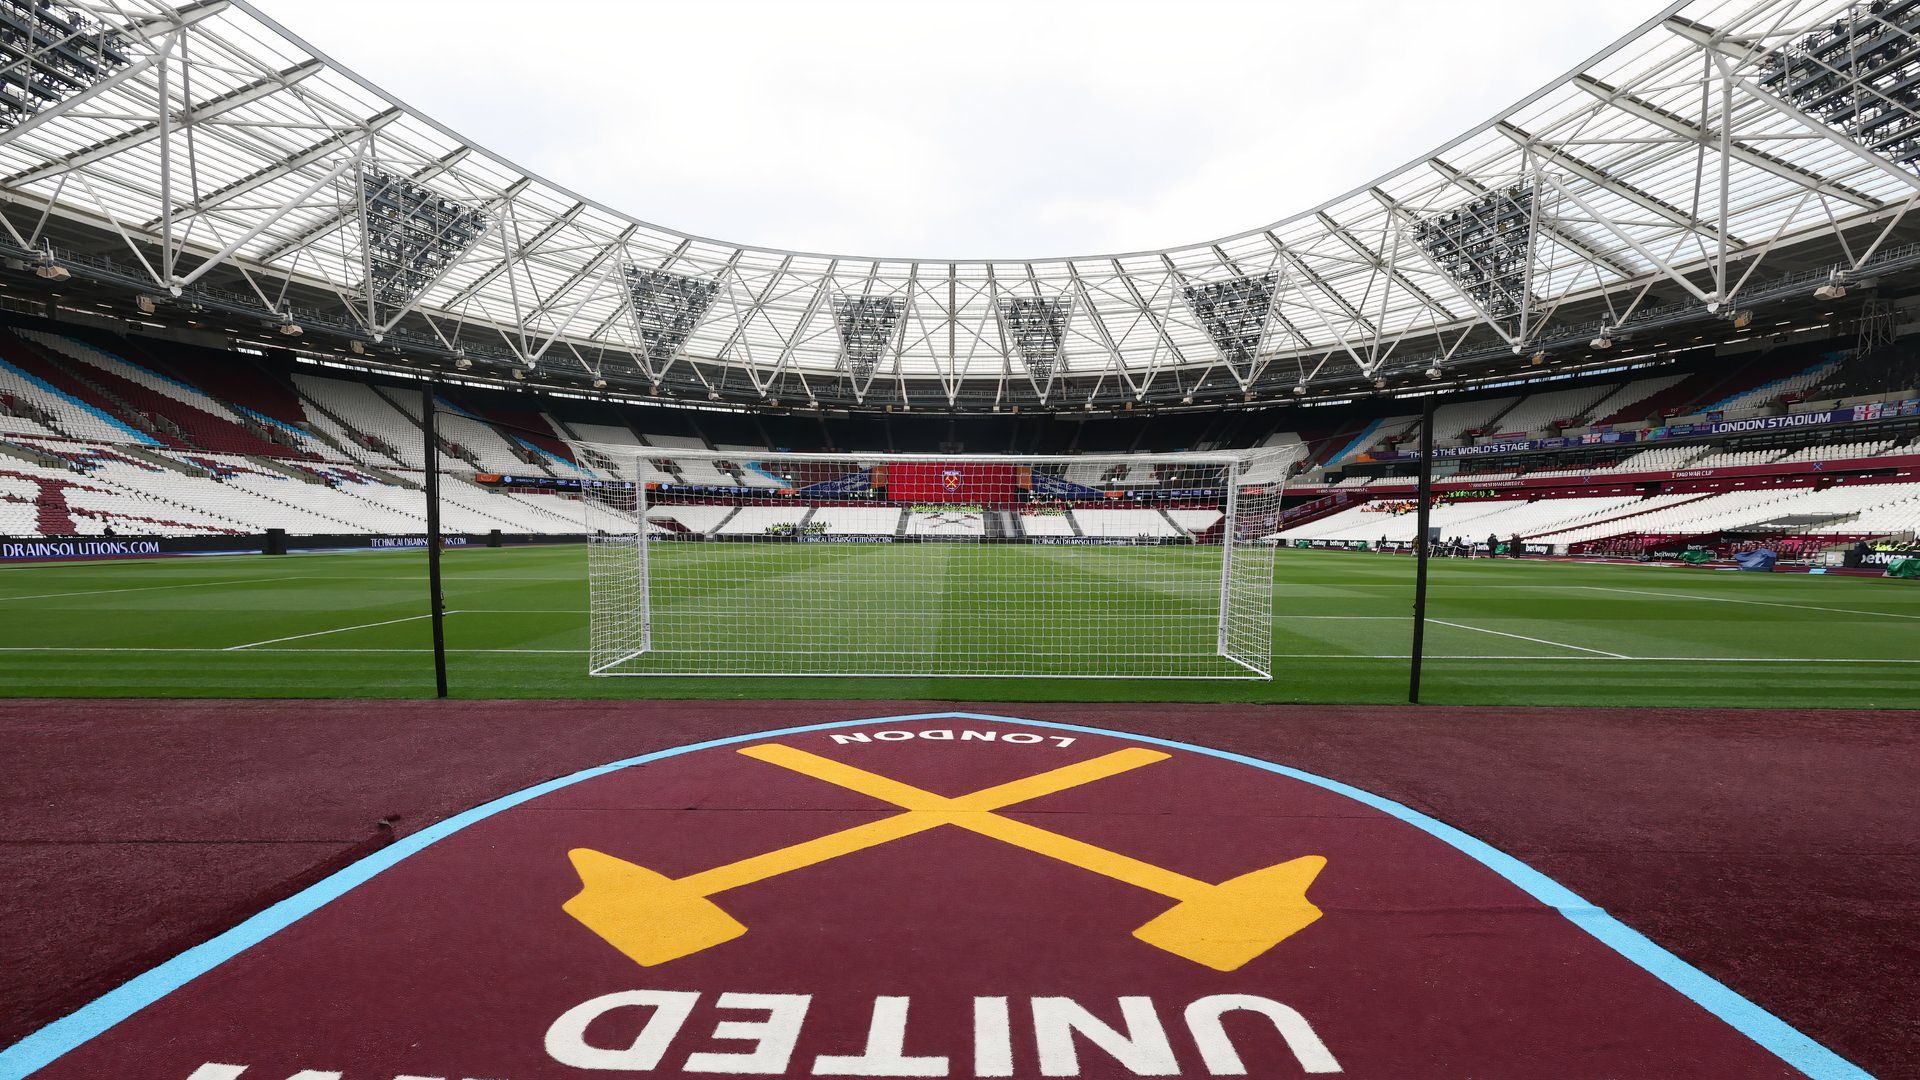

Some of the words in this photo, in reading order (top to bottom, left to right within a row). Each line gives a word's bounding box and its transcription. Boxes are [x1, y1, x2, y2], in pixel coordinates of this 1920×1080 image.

[1711, 418, 1765, 434] LONDON
[1767, 412, 1831, 428] STADIUM
[1439, 448, 1456, 456] THE
[1458, 443, 1498, 455] WORLD'S
[1500, 441, 1530, 452] STAGE
[2, 541, 160, 557] DRAINSOLUTIONS.COM
[1312, 539, 1326, 547] betway
[1525, 543, 1549, 554] betway
[829, 730, 1077, 748] LONDON
[543, 989, 1344, 1078] UNITED
